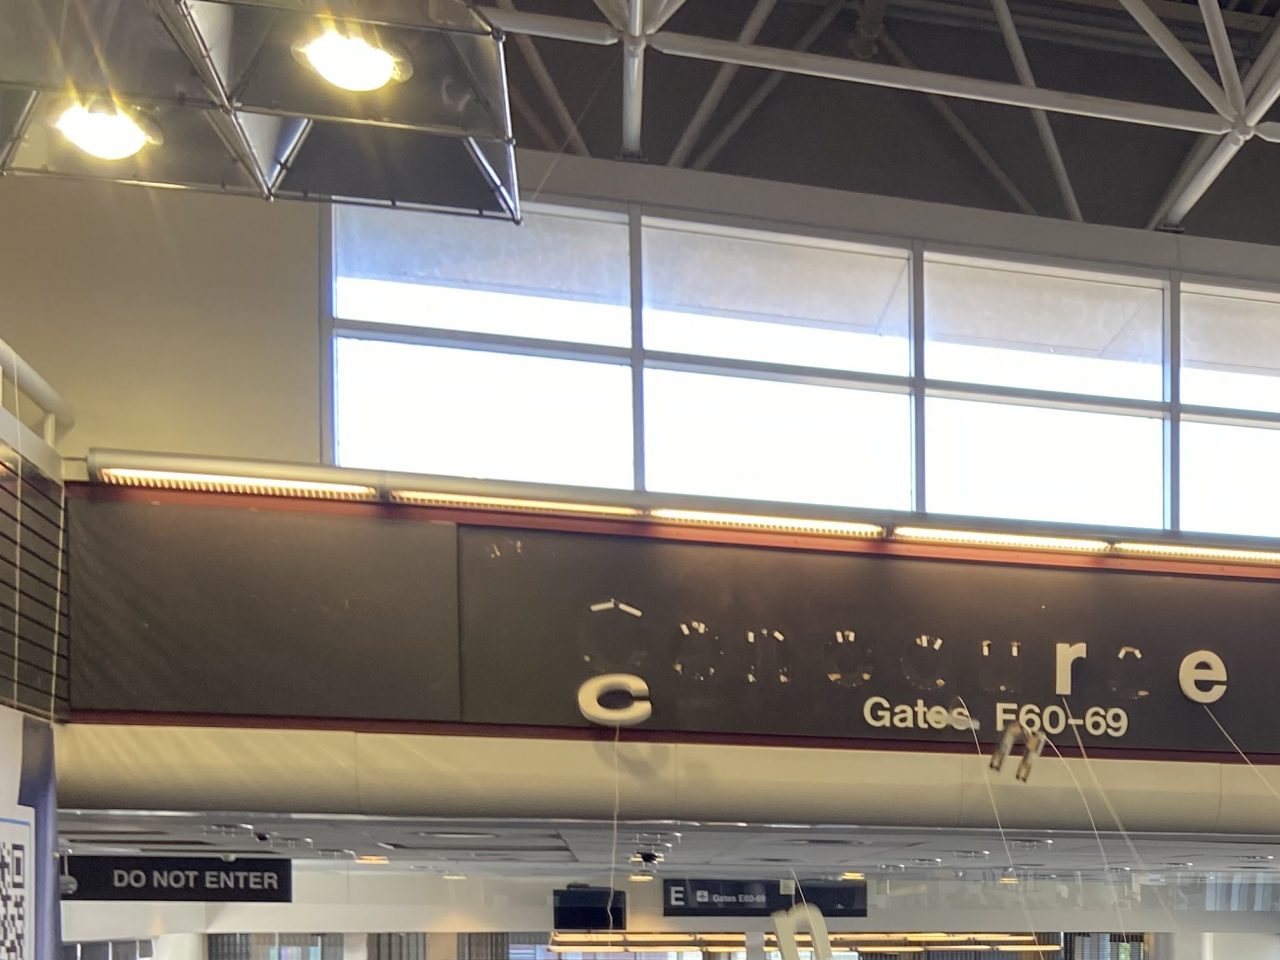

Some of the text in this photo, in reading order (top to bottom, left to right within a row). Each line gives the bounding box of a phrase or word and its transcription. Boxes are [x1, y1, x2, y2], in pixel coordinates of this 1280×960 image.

[863, 696, 1128, 737] Gates F60-69
[113, 870, 279, 890] DO NOT ENTER
[670, 886, 685, 906] E
[713, 894, 737, 902] Gates
